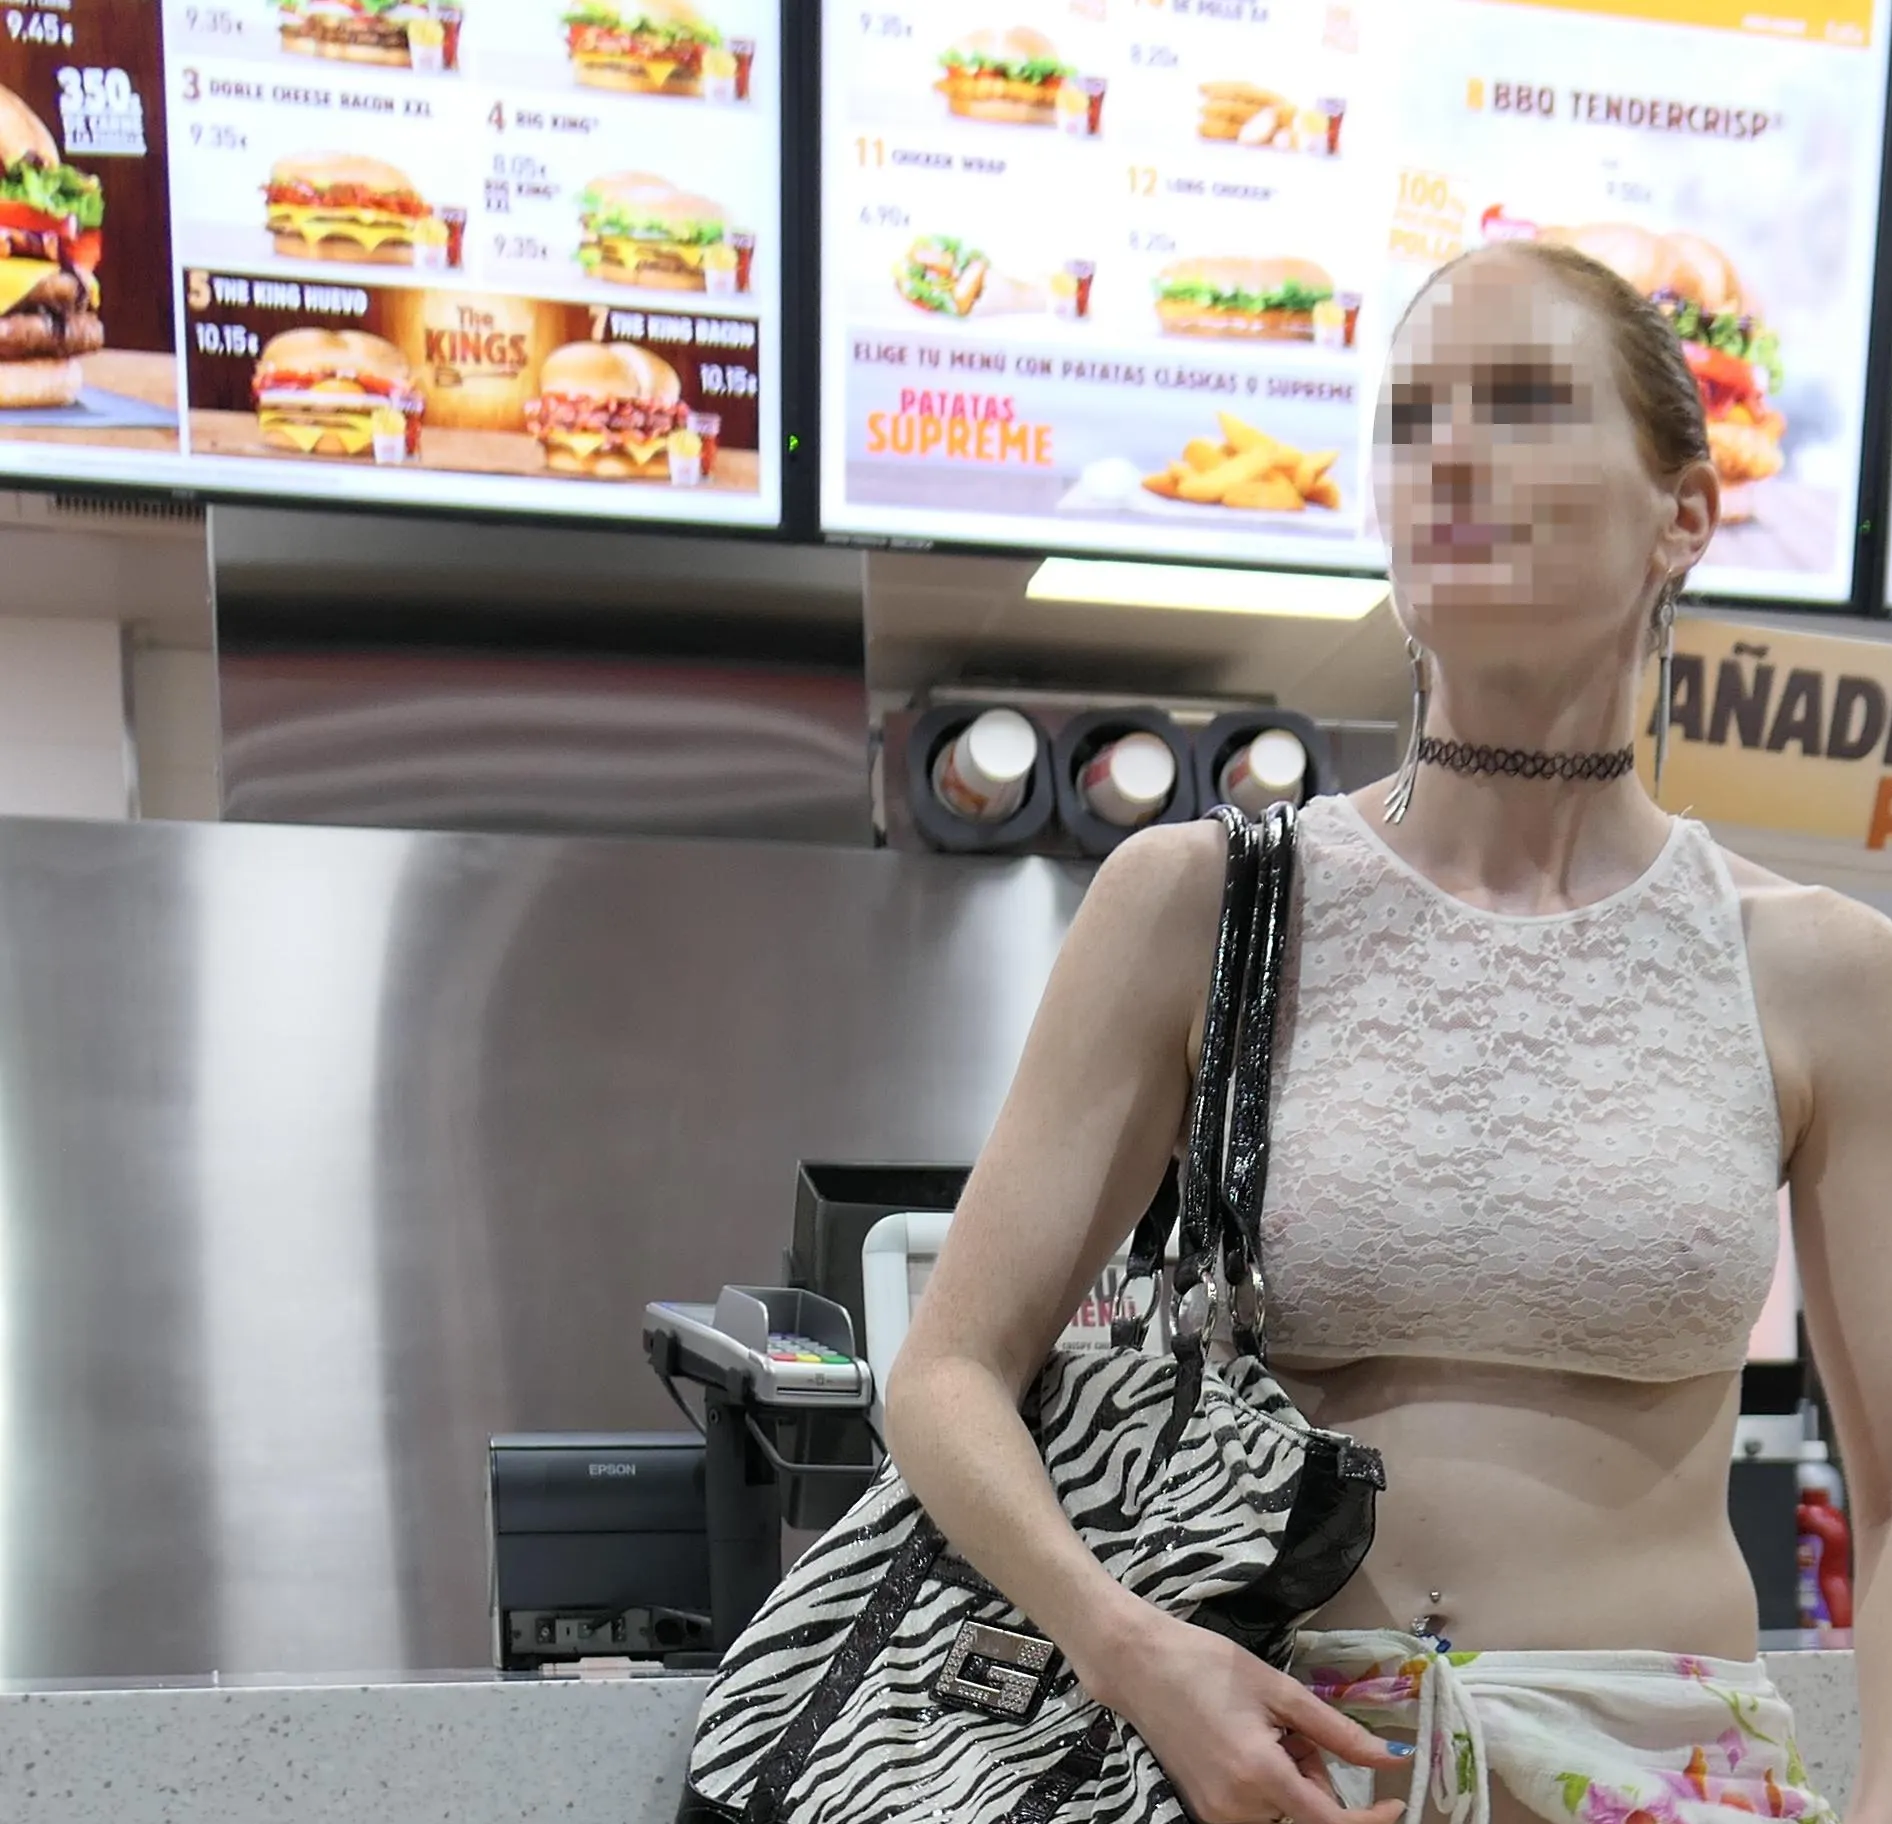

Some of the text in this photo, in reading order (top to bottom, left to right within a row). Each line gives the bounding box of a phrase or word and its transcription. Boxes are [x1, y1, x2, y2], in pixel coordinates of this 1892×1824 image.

[182, 67, 432, 116] 3 DOBLE CHEESE BACON XXL
[1493, 82, 1555, 116] BBQ
[487, 101, 506, 132] 4
[516, 110, 543, 129] BIG
[854, 137, 884, 168] 11
[962, 156, 1006, 174] WRAP
[1126, 166, 1158, 197] 12
[252, 280, 301, 311] KING
[458, 306, 494, 331] The
[610, 311, 645, 340] THE
[647, 314, 694, 344] KING
[695, 319, 756, 348] BACON
[424, 328, 529, 367] KINGS
[853, 342, 908, 365] ELIGE
[918, 347, 940, 369] TU
[1015, 357, 1052, 375] CON
[1062, 360, 1145, 385] PATATAS
[1246, 377, 1258, 394] O
[1267, 377, 1355, 403] SUPREME
[900, 387, 1015, 423] PATATAS
[867, 411, 1053, 466] SUPREME
[1070, 1296, 1136, 1328] ENÚ
[588, 1464, 636, 1476] EPSON
